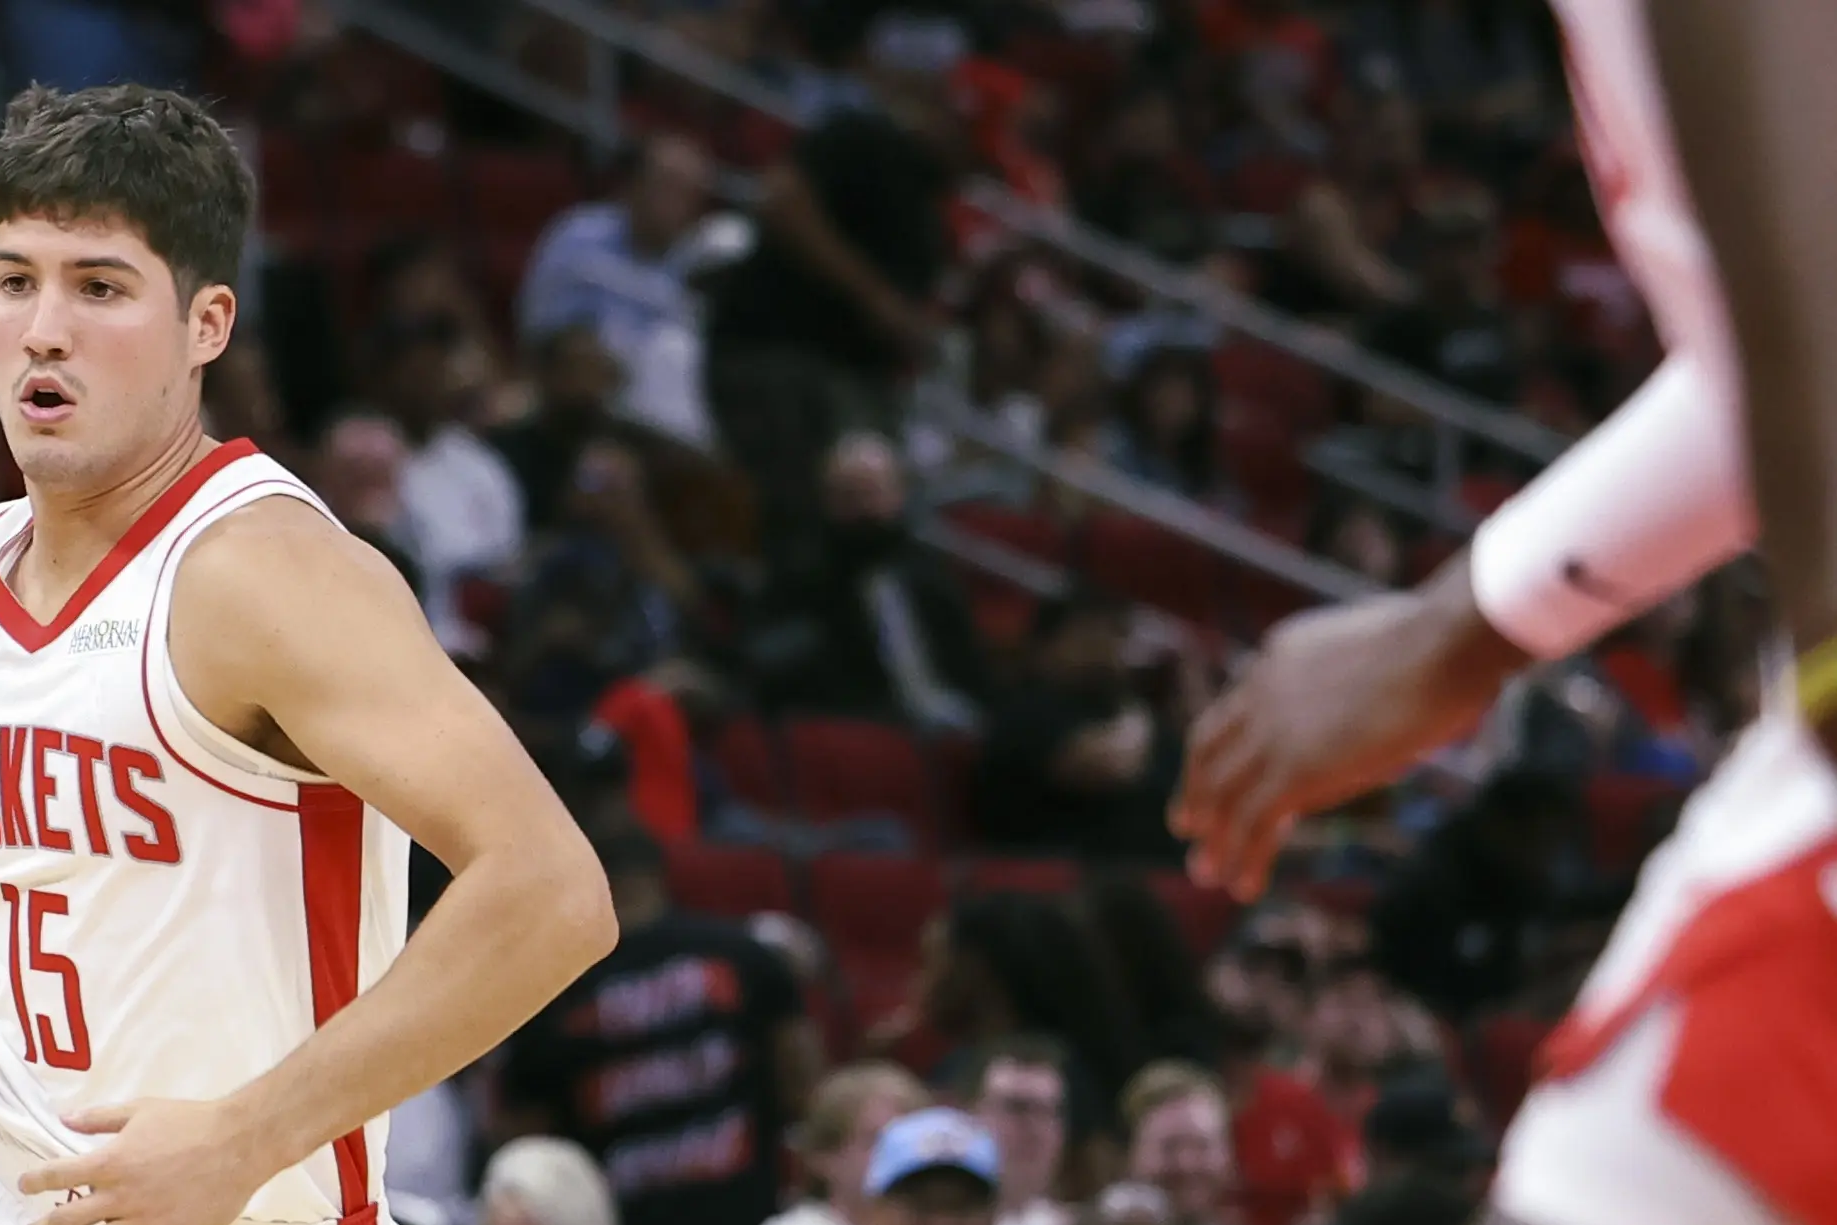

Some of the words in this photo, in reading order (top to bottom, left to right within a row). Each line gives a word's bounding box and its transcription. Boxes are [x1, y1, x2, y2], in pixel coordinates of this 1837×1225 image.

[72, 618, 140, 641] MEMORIAL
[67, 630, 138, 655] HERMANN
[0, 881, 91, 1072] 15
